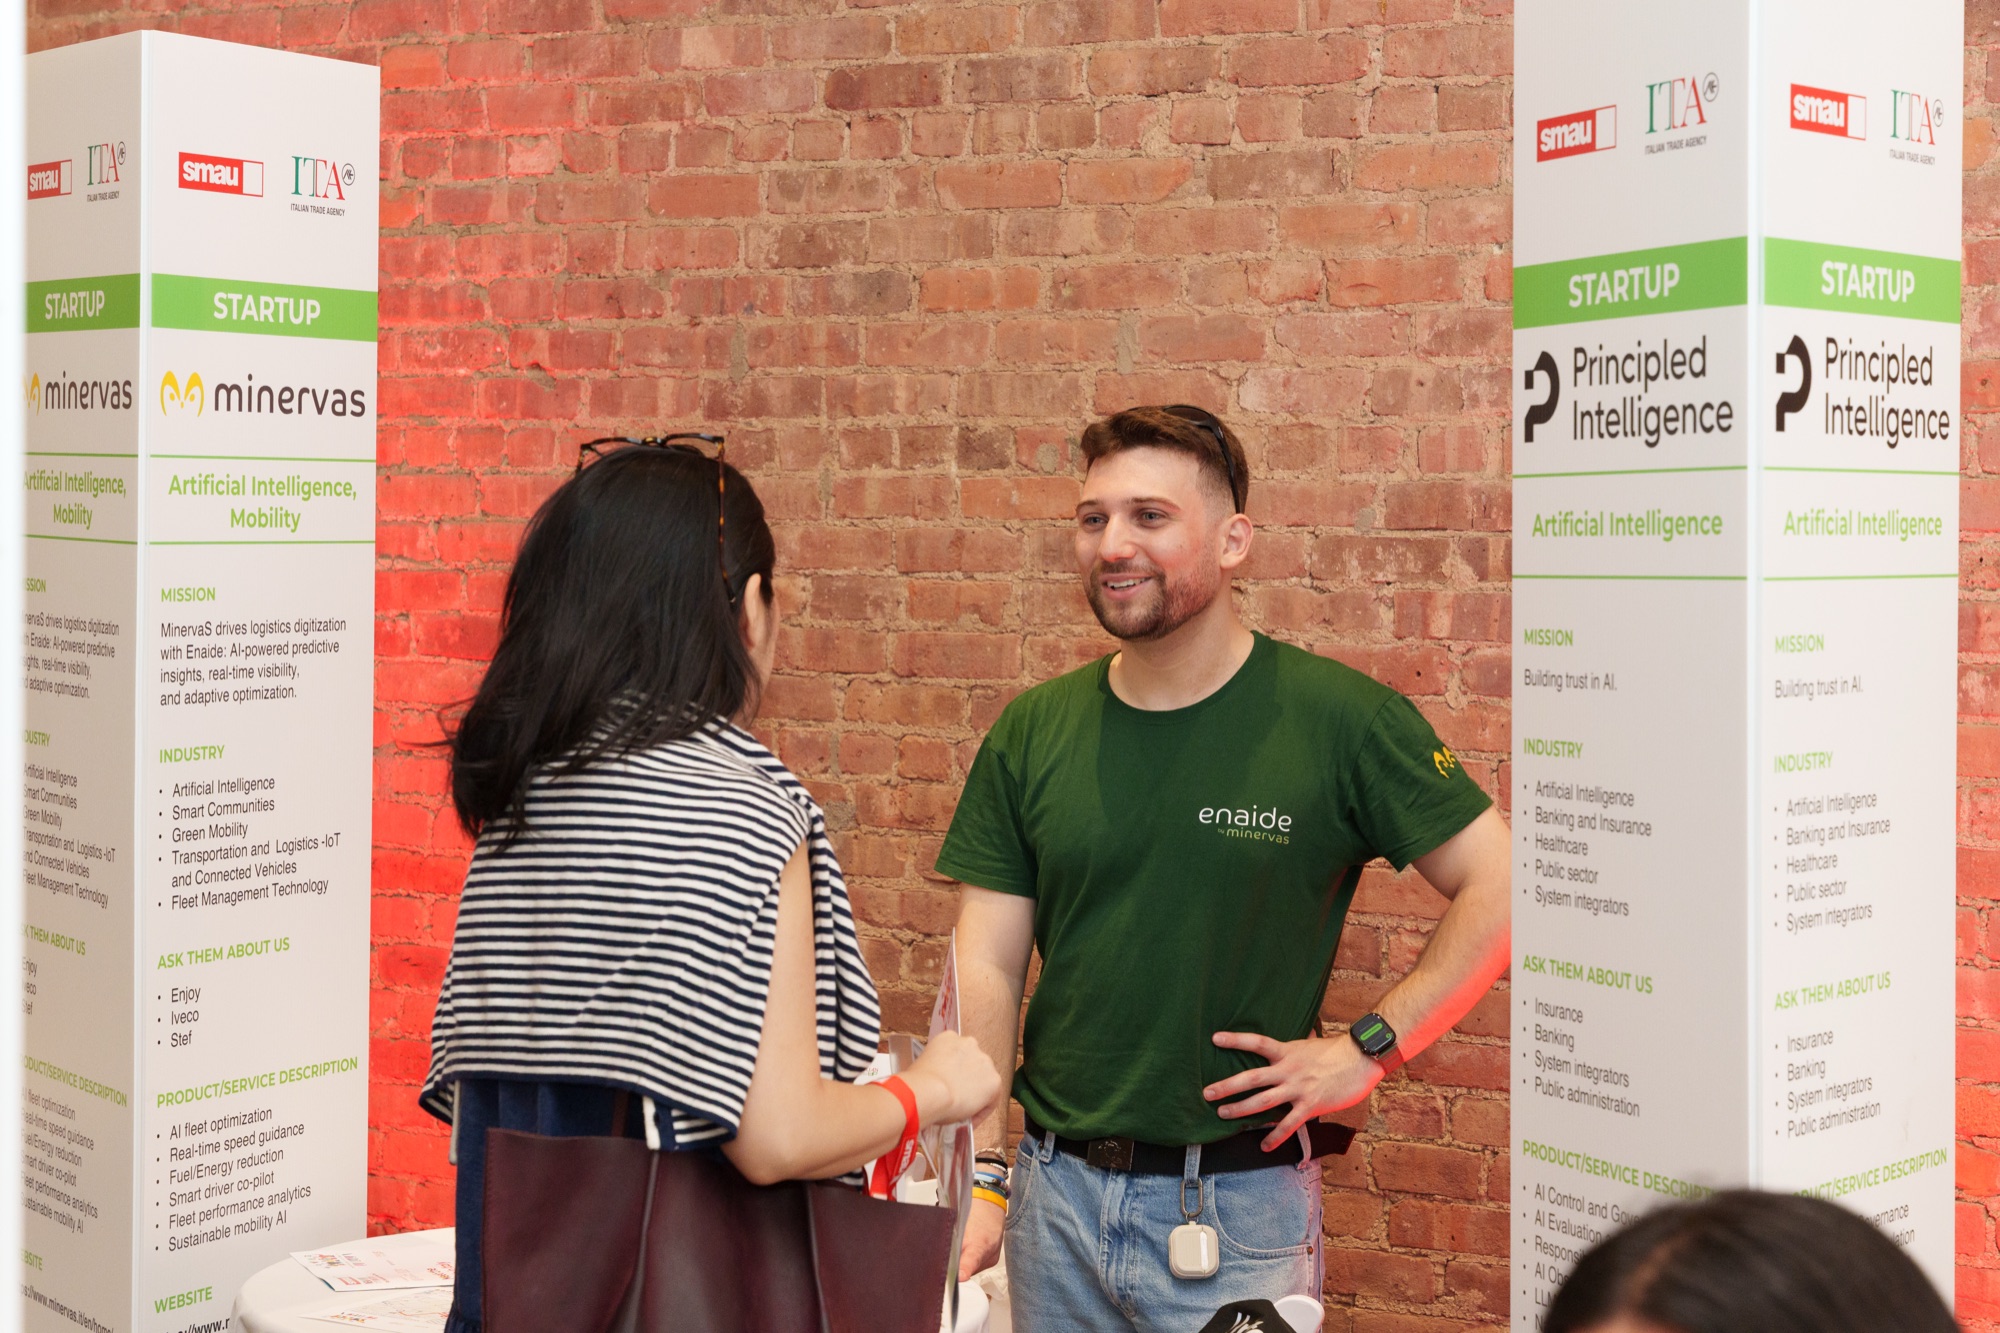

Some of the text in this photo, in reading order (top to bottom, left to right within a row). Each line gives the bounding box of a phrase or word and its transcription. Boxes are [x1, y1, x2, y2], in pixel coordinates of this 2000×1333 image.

[1646, 77, 1707, 135] ITA
[1794, 93, 1845, 128] smau
[1891, 89, 1936, 145] ITA
[1540, 117, 1592, 153] smau
[1645, 135, 1707, 155] ITALIAN TRADE AGENCY
[87, 144, 119, 186] ITA
[183, 161, 239, 186] smau
[292, 156, 345, 200] ITA
[30, 170, 58, 192] smau
[290, 203, 345, 217] ITALIAN TRADE AGENCY
[1569, 262, 1680, 308] STARTUP
[1821, 260, 1916, 304] STARTUP
[45, 291, 105, 319] STARTUP
[214, 293, 320, 325] STARTUP
[1573, 334, 1707, 395] Principled
[1825, 338, 1933, 394] Principled
[45, 371, 132, 409] minervas
[215, 374, 366, 417] minervas
[1573, 398, 1733, 449] Intelligence
[1825, 392, 1950, 449] Intelligence
[65, 472, 126, 498] Intelligence,
[168, 473, 357, 502] Artificial Intelligence,
[53, 504, 92, 530] Mobility
[230, 506, 301, 533] Mobility
[1532, 508, 1723, 543] Artificial Intelligence
[1784, 508, 1942, 542] Artificial Intelligence
[161, 587, 216, 602] MISSION
[161, 617, 346, 638] MinervaS drives logistics digitization
[1524, 629, 1573, 646] MISSION
[160, 639, 339, 660] with Enaide: AI-powered predictive
[1775, 634, 1824, 653] MISSION
[160, 663, 299, 686] insights, real-time visibility,
[1524, 668, 1617, 693] Building trust in AI.
[160, 684, 297, 707] and adaptive optimization.
[159, 745, 225, 763] INDUSTRY
[1524, 738, 1583, 759] INDUSTRY
[1774, 751, 1833, 773] INDUSTRY
[172, 777, 275, 798] Artificial Intelligence
[1535, 780, 1634, 809] Artificial Intelligence
[172, 797, 275, 820] Smart Communities
[1199, 805, 1292, 832] enaide
[1787, 793, 1877, 816] Artificial Intelligence
[172, 822, 248, 843] Green Mobility
[1227, 827, 1289, 844] minervas
[1535, 805, 1652, 837] Banking and Insurance
[1787, 819, 1891, 846] Banking and Insurance
[172, 844, 248, 866] Transportation
[250, 840, 270, 857] and
[276, 836, 319, 856] Logistics
[1535, 833, 1588, 856] Healthcare
[171, 860, 297, 888] and Connected Vehicles
[1535, 858, 1598, 884] Public sector
[1787, 854, 1838, 874] Healthcare
[172, 879, 329, 910] Fleet Management Technology
[1535, 885, 1629, 917] System integrators
[1787, 881, 1847, 902] Public sector
[1787, 904, 1872, 934] System integrators
[157, 937, 290, 970] ASK THEM ABOUT US
[1523, 954, 1653, 994] ASK THEM ABOUT US
[171, 986, 201, 1005] Enjoy
[1775, 971, 1891, 1010] ASK THEM ABOUT US
[171, 1010, 199, 1025] Iveco
[1535, 998, 1583, 1024] Insurance
[171, 1030, 192, 1048] Stef
[1535, 1023, 1574, 1052] Banking
[1788, 1030, 1834, 1052] Insurance
[157, 1056, 358, 1108] PRODUCT/SERVICE DESCRIPTION
[1535, 1050, 1629, 1088] System integrators
[1787, 1060, 1825, 1082] Banking
[1535, 1076, 1640, 1117] Public administration
[1788, 1077, 1872, 1112] System integrators
[170, 1108, 272, 1140] AI fleet optimization
[1788, 1102, 1880, 1138] Public administration
[170, 1124, 304, 1162] Real-time speed guidance
[170, 1149, 284, 1185] Fuel/Energy reduction
[1523, 1140, 1639, 1186] PRODUCT/SERVICE
[1883, 1148, 1947, 1182] DESCRIPTION
[169, 1171, 274, 1207] Smart driver co-pilot
[1535, 1184, 1607, 1219] AI Control and
[169, 1186, 311, 1229] Fleet performance analytics
[168, 1210, 286, 1252] Sustainable mobility AI
[1535, 1210, 1601, 1243] AI Evaluation
[154, 1286, 212, 1314] WEBSITE
